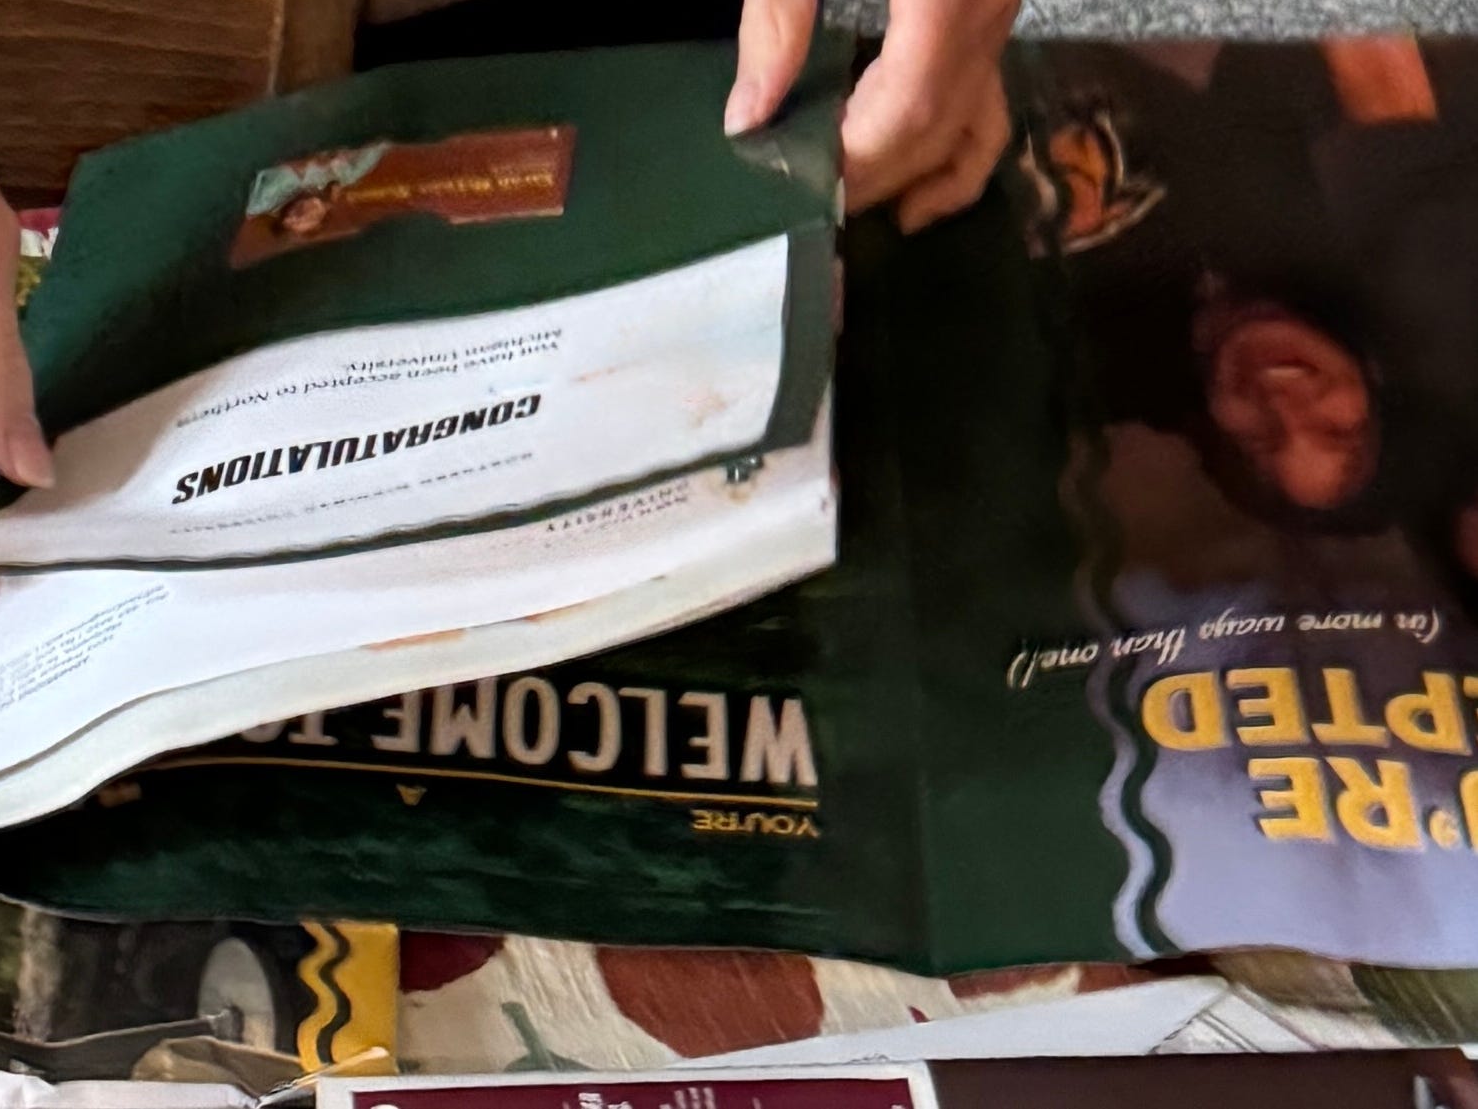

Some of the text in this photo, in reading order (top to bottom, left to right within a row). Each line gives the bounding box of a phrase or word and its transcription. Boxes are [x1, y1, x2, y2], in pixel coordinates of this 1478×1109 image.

[304, 370, 403, 393] accepted
[172, 394, 542, 504] CONGRATULATIONS
[1198, 607, 1285, 641] ways
[1297, 611, 1383, 631] more
[1110, 624, 1186, 666] than
[372, 675, 819, 787] WELCOME
[1141, 666, 1478, 755] PTED
[692, 808, 820, 838] YOU'RE
[1247, 756, 1478, 852] 'RE
